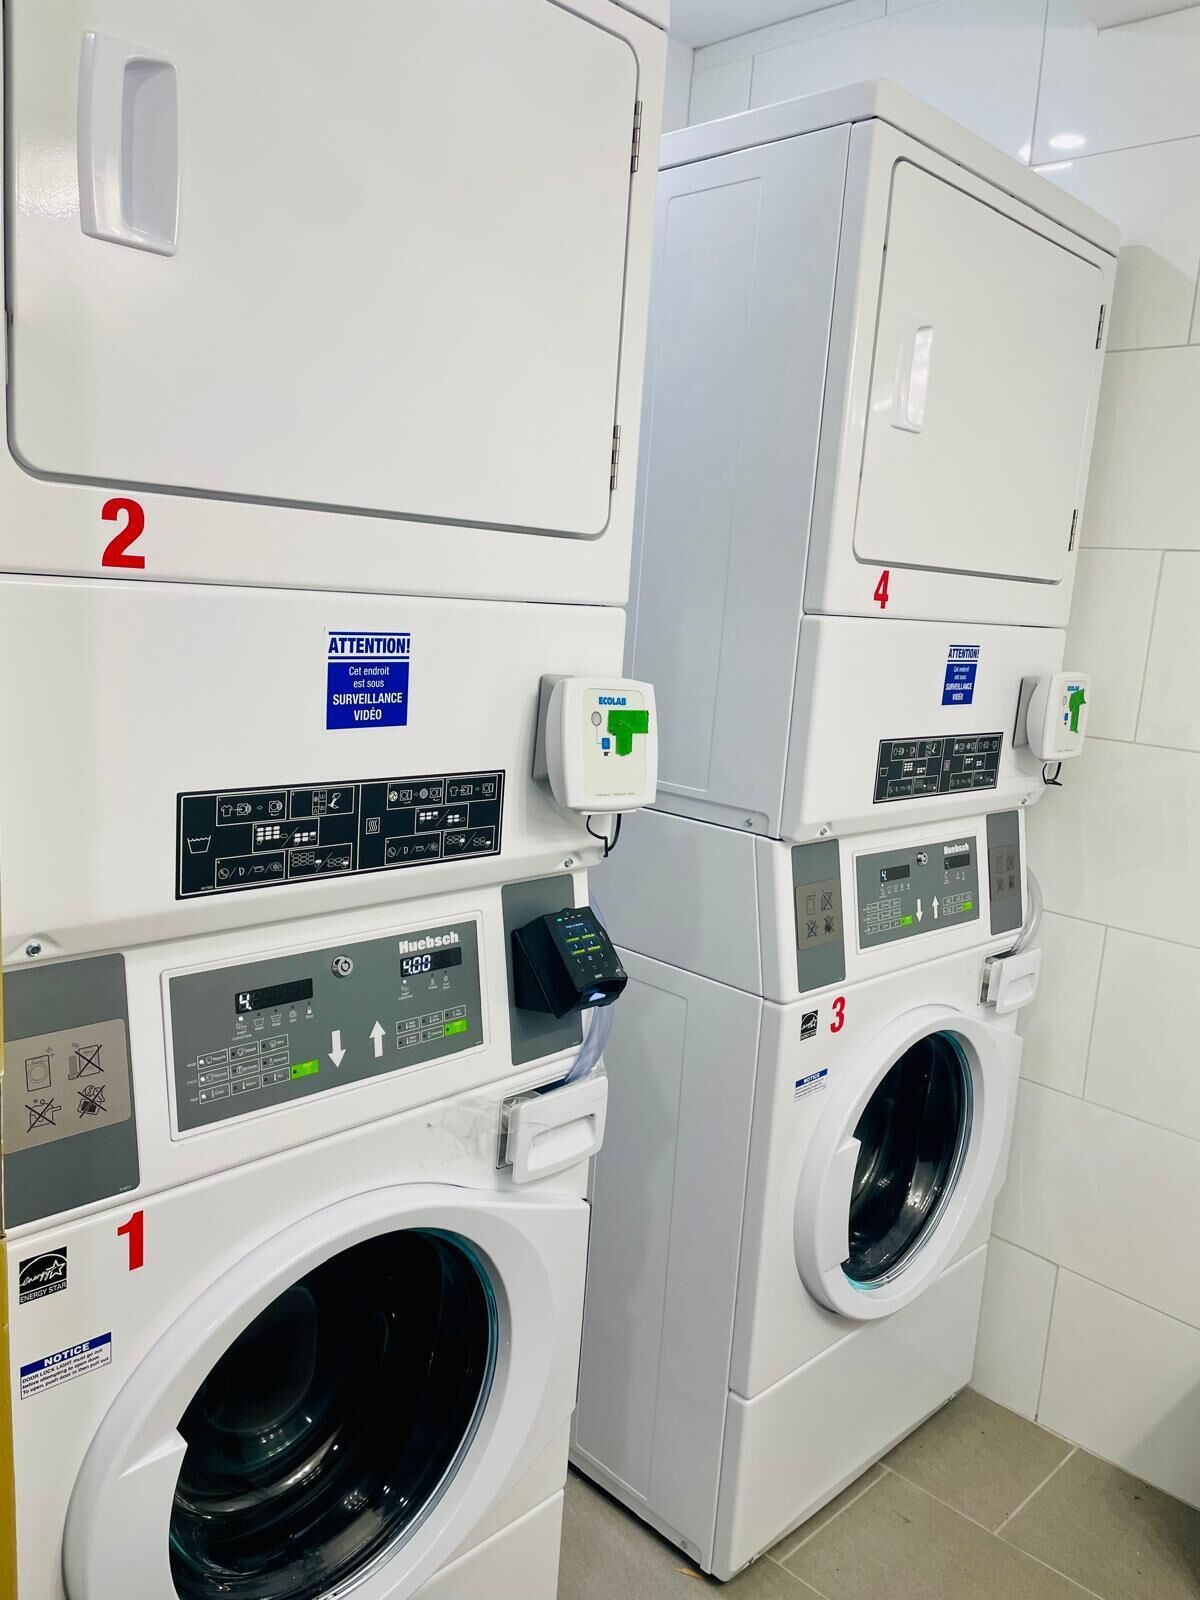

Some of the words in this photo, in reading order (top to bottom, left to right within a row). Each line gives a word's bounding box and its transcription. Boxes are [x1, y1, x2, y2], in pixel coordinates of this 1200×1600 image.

[101, 497, 145, 569] 2
[873, 570, 890, 609] 4
[328, 637, 411, 654] ATTENTION!
[948, 648, 980, 659] ATTENTION!
[349, 666, 361, 676] Cet
[363, 666, 390, 676] endroit
[353, 680, 365, 688] est
[366, 680, 385, 688] sous
[332, 692, 403, 705] SURVEILLANCE
[598, 696, 627, 706] ECOLAB
[354, 706, 382, 721] VIDÉO
[943, 842, 970, 855] Huebsch
[398, 931, 459, 955] Huebsch
[830, 996, 846, 1034] 3
[117, 1210, 144, 1271] 1
[20, 1286, 48, 1304] ENERGY
[48, 1281, 67, 1295] STAR
[22, 1373, 39, 1384] DOOR
[39, 1367, 55, 1377] LOCK
[56, 1361, 72, 1371] LIGHT
[73, 1354, 86, 1363] must
[94, 1348, 103, 1356] out
[44, 1342, 90, 1367] NOTICE
[22, 1379, 39, 1389] before
[75, 1360, 87, 1369] open
[45, 1377, 59, 1387] push
[59, 1372, 71, 1381] door
[78, 1364, 90, 1373] then
